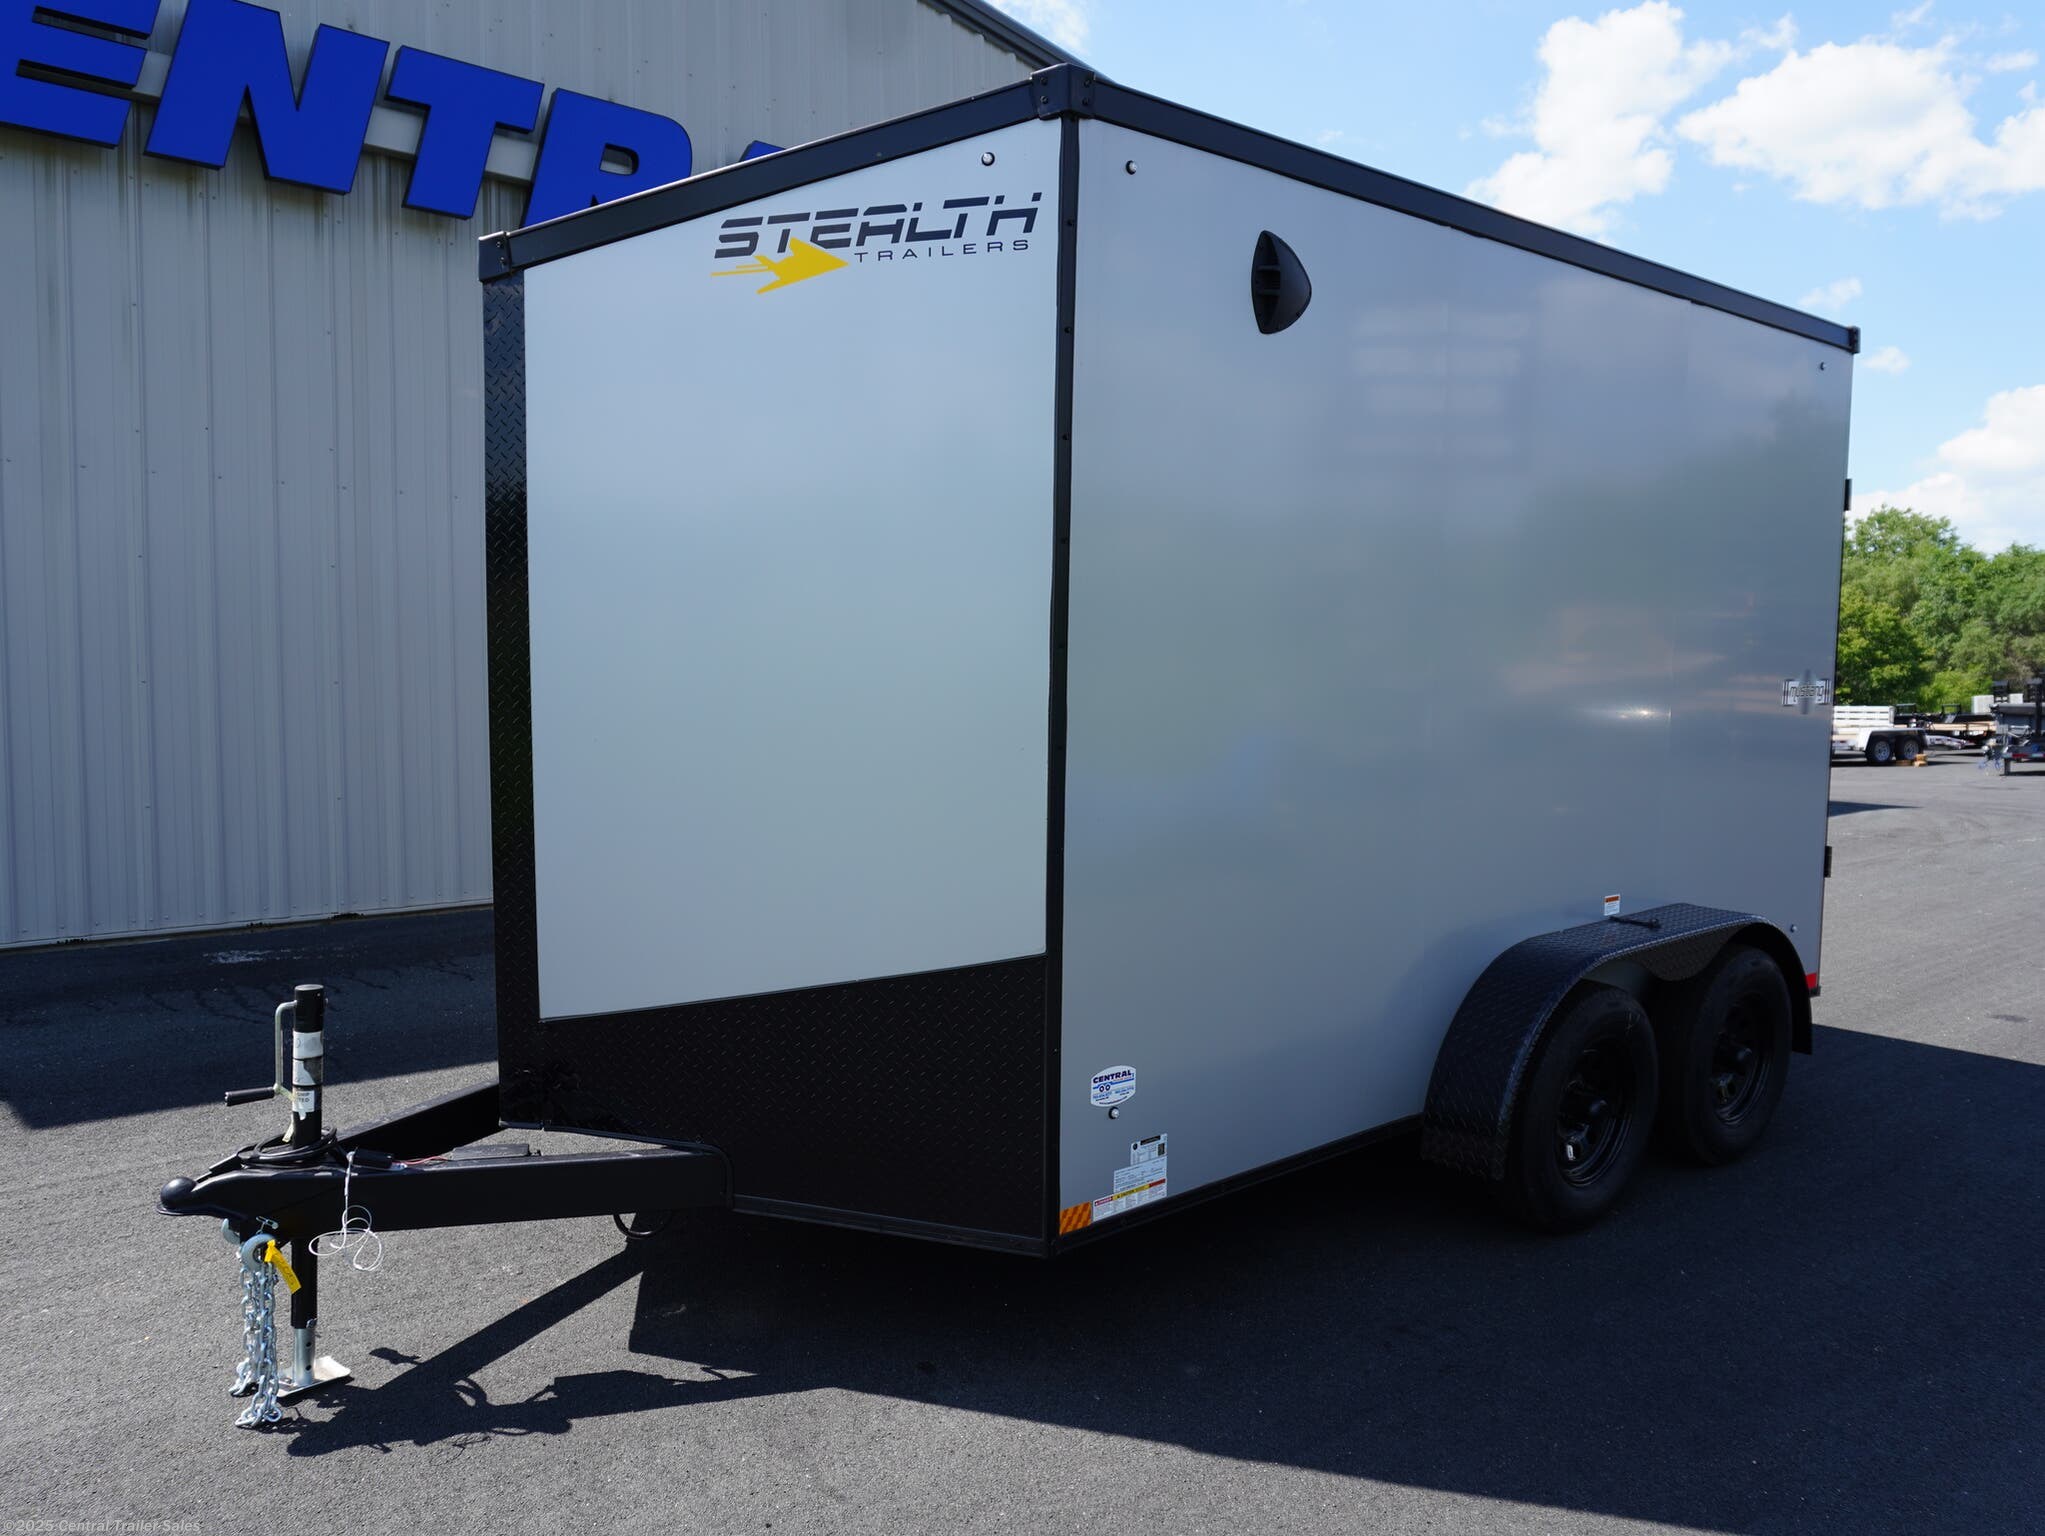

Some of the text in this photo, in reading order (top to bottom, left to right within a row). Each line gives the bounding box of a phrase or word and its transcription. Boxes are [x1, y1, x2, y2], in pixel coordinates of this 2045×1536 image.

[0, 0, 786, 228] ENTR
[714, 192, 1042, 259] STEALTH
[854, 239, 1029, 263] TRAILERS
[1093, 1070, 1131, 1084] CENTRAL
